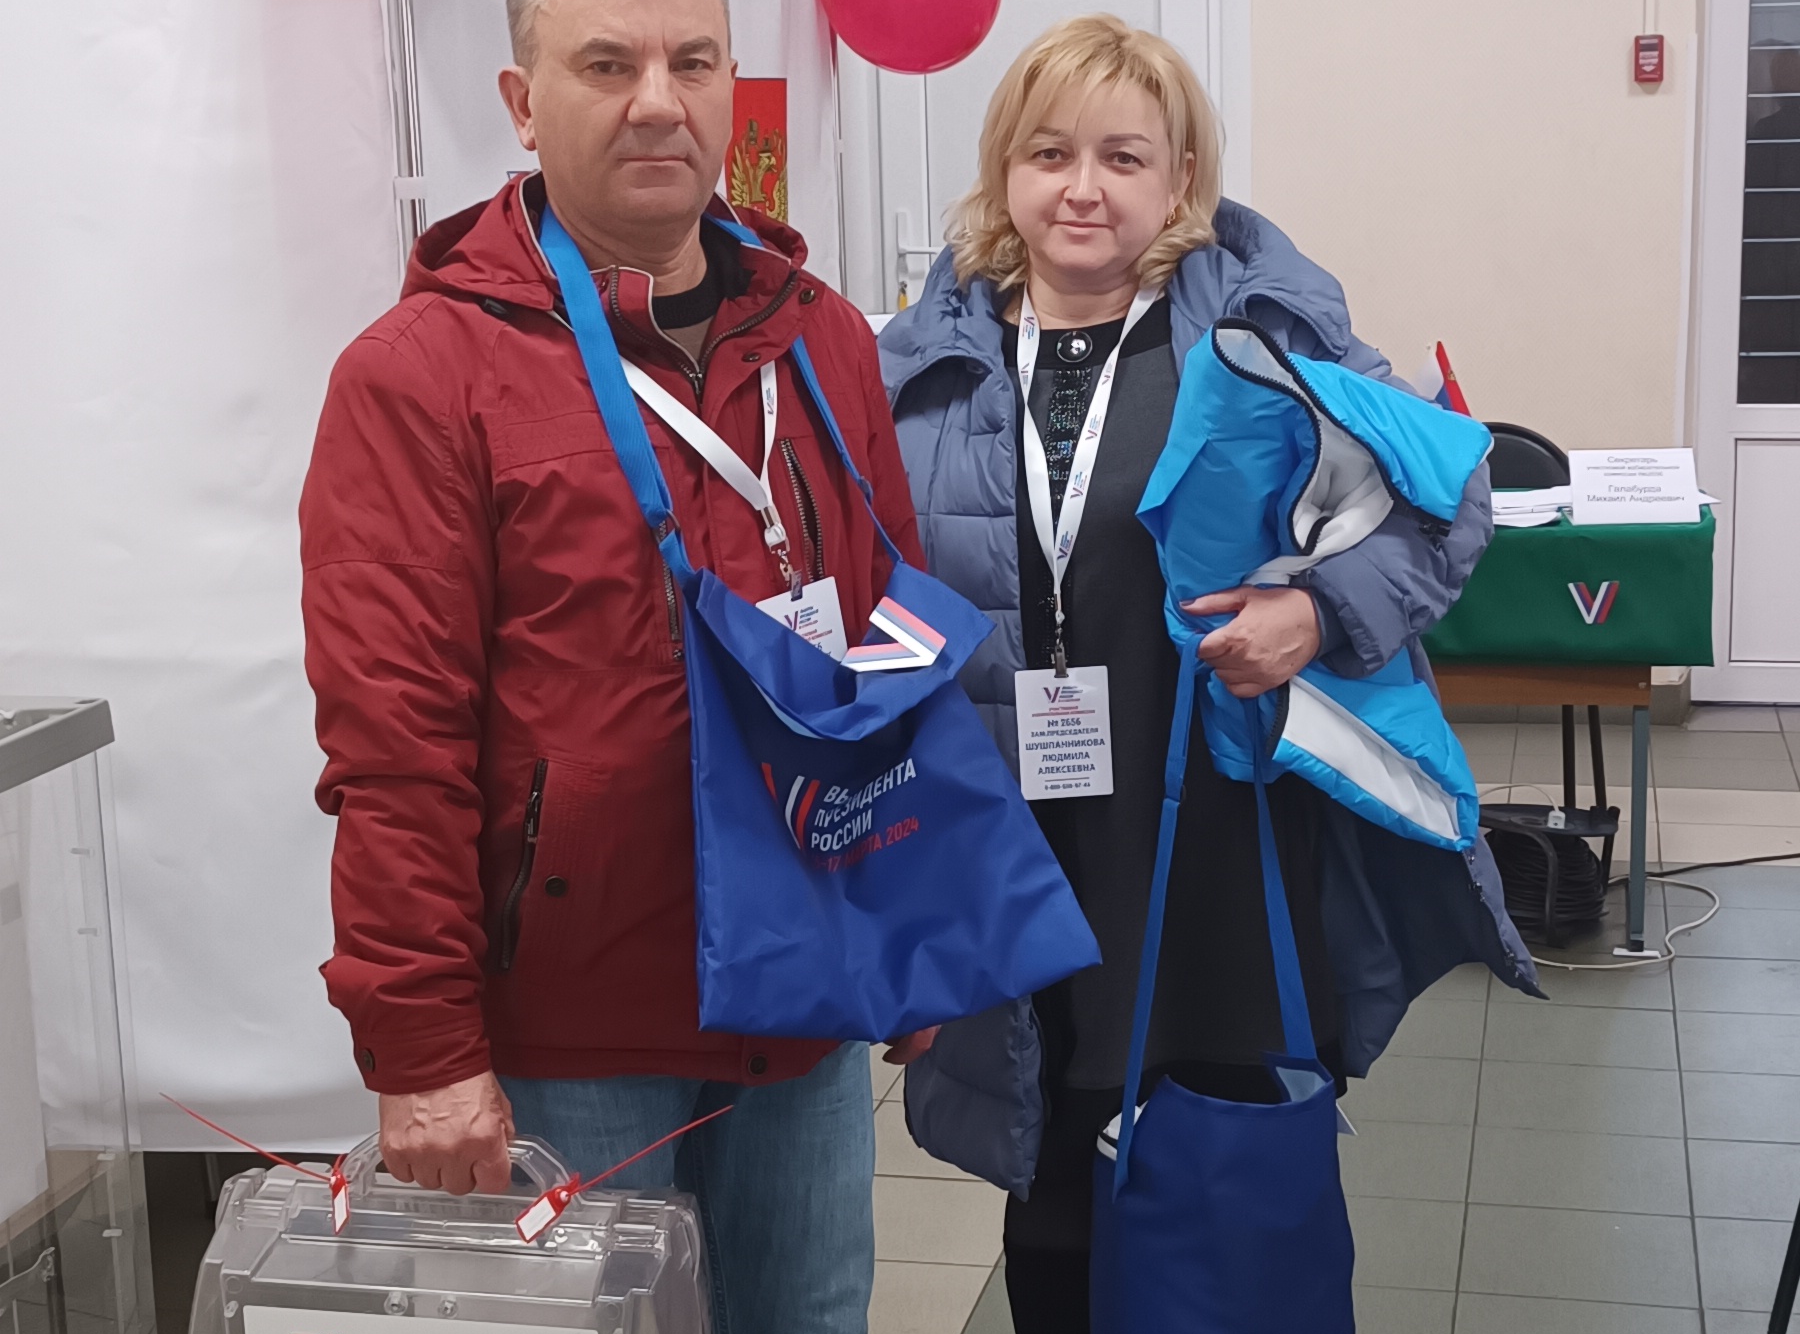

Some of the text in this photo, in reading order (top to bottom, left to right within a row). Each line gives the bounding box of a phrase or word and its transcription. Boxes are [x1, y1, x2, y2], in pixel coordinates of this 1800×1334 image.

[1586, 494, 1626, 502] Михаил
[1060, 717, 1082, 727] 2656
[1025, 738, 1106, 751] ШУШПАННИКОВА
[1041, 751, 1091, 763] ЛЮДМИЛА
[1037, 763, 1096, 775] АЛЕКСЕЕВНА
[814, 758, 917, 828] ПРЕЗИДЕНТА
[811, 808, 873, 852] РОССИИ
[886, 815, 920, 847] 2024
